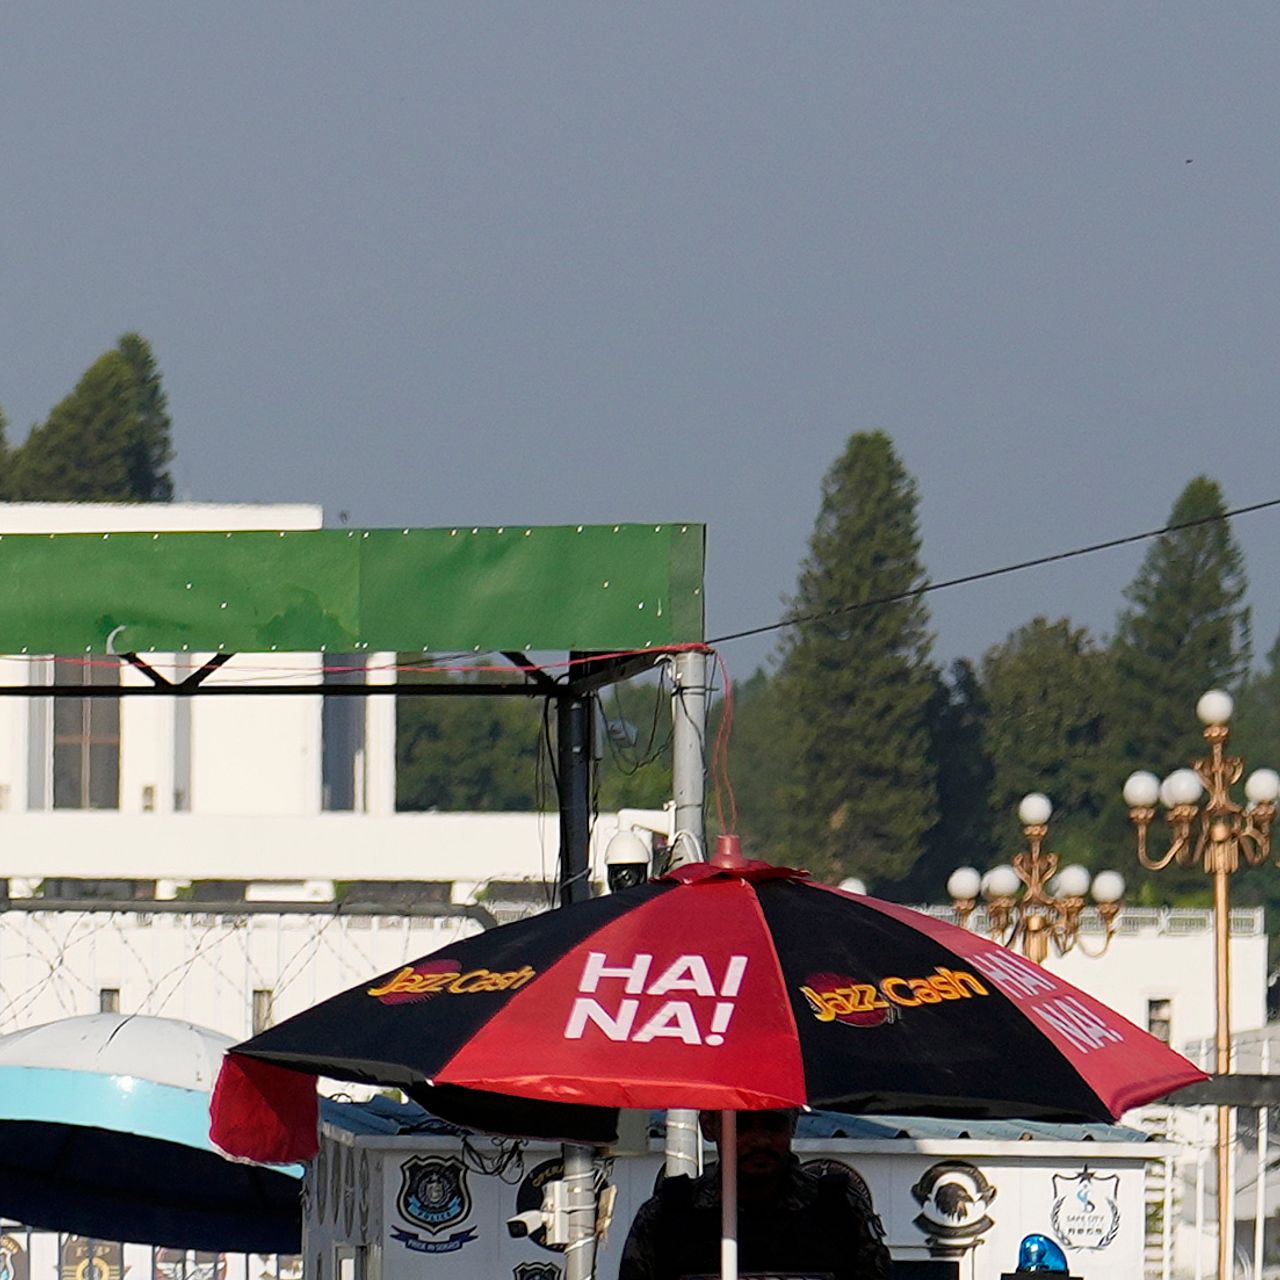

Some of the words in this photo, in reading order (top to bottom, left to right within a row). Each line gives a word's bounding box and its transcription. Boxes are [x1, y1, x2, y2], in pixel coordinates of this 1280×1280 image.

[578, 951, 749, 997] HAI
[964, 950, 1057, 1000] HAI
[564, 998, 736, 1046] NA!
